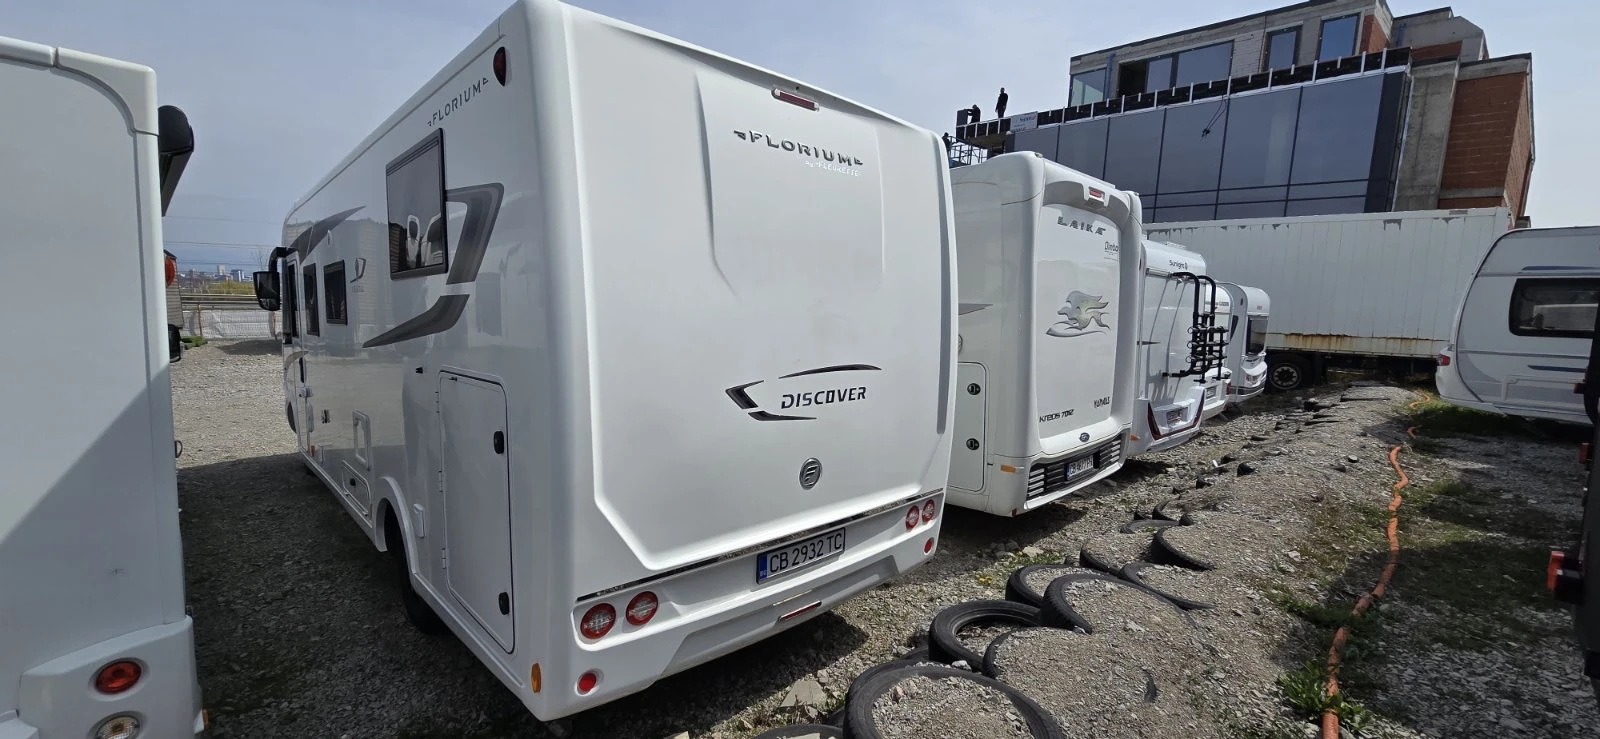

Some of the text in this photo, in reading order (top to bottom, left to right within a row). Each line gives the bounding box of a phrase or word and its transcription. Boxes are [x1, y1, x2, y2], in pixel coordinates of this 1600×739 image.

[432, 79, 482, 126] FLORIUM
[748, 129, 853, 167] FLORIUM
[1057, 215, 1106, 236] LAIKA
[781, 386, 867, 409] DISCOVER
[769, 532, 842, 573] CB 2932 TC
